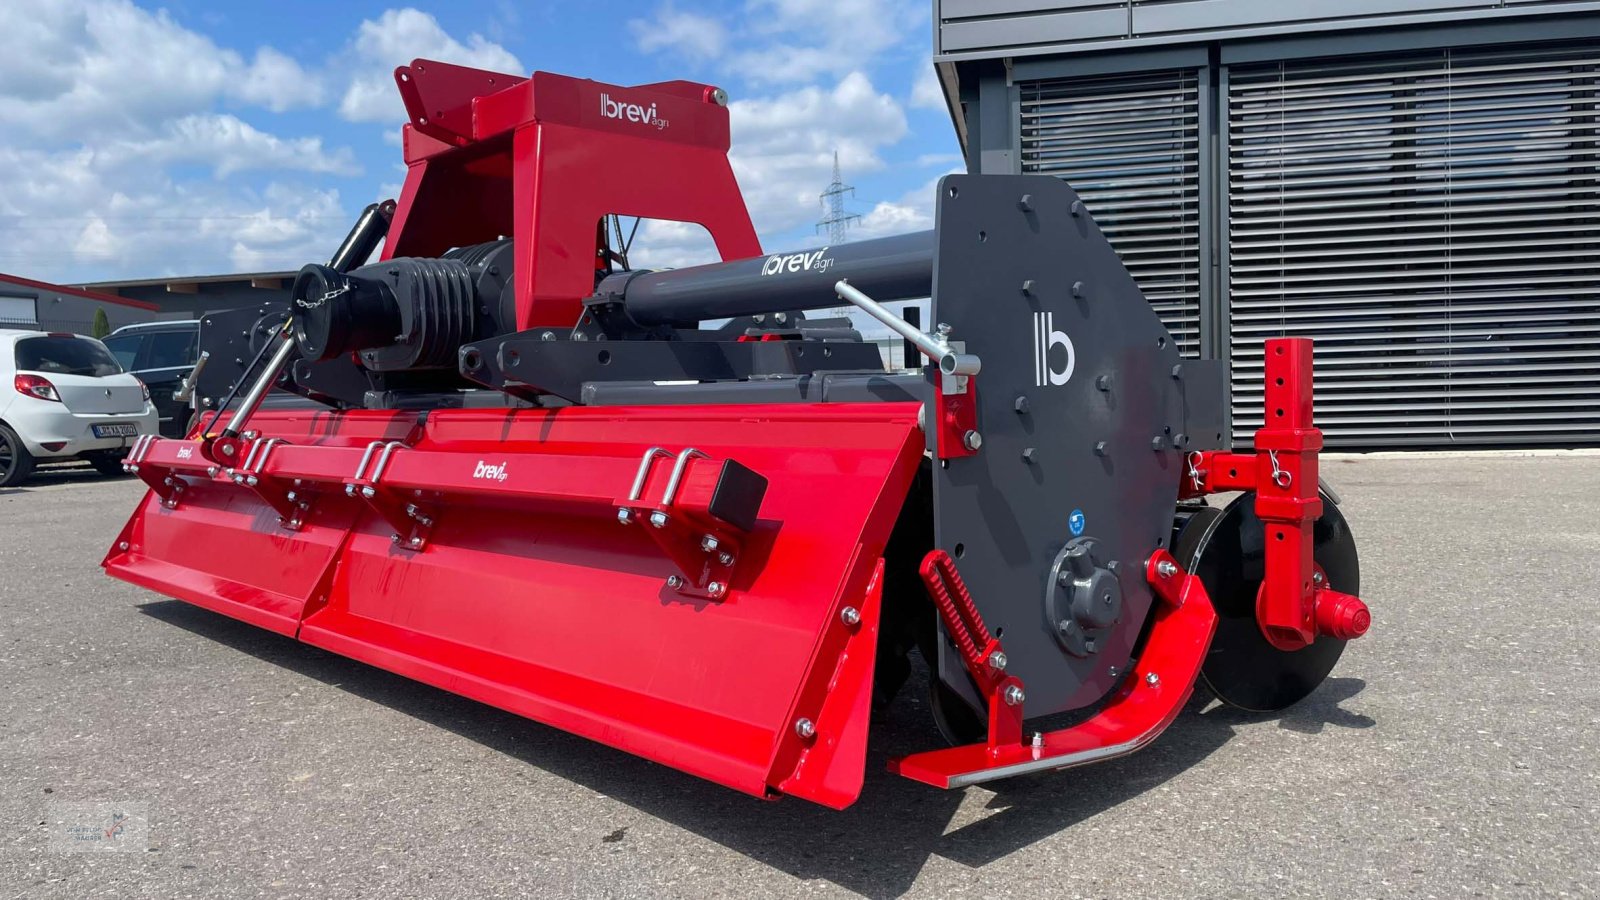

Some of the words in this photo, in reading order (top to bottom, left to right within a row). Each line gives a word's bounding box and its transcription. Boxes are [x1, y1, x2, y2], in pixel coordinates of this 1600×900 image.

[600, 92, 656, 124] brevi
[651, 117, 670, 130] agri
[761, 246, 829, 276] brevi
[813, 258, 834, 273] agri
[472, 460, 507, 479] brevi
